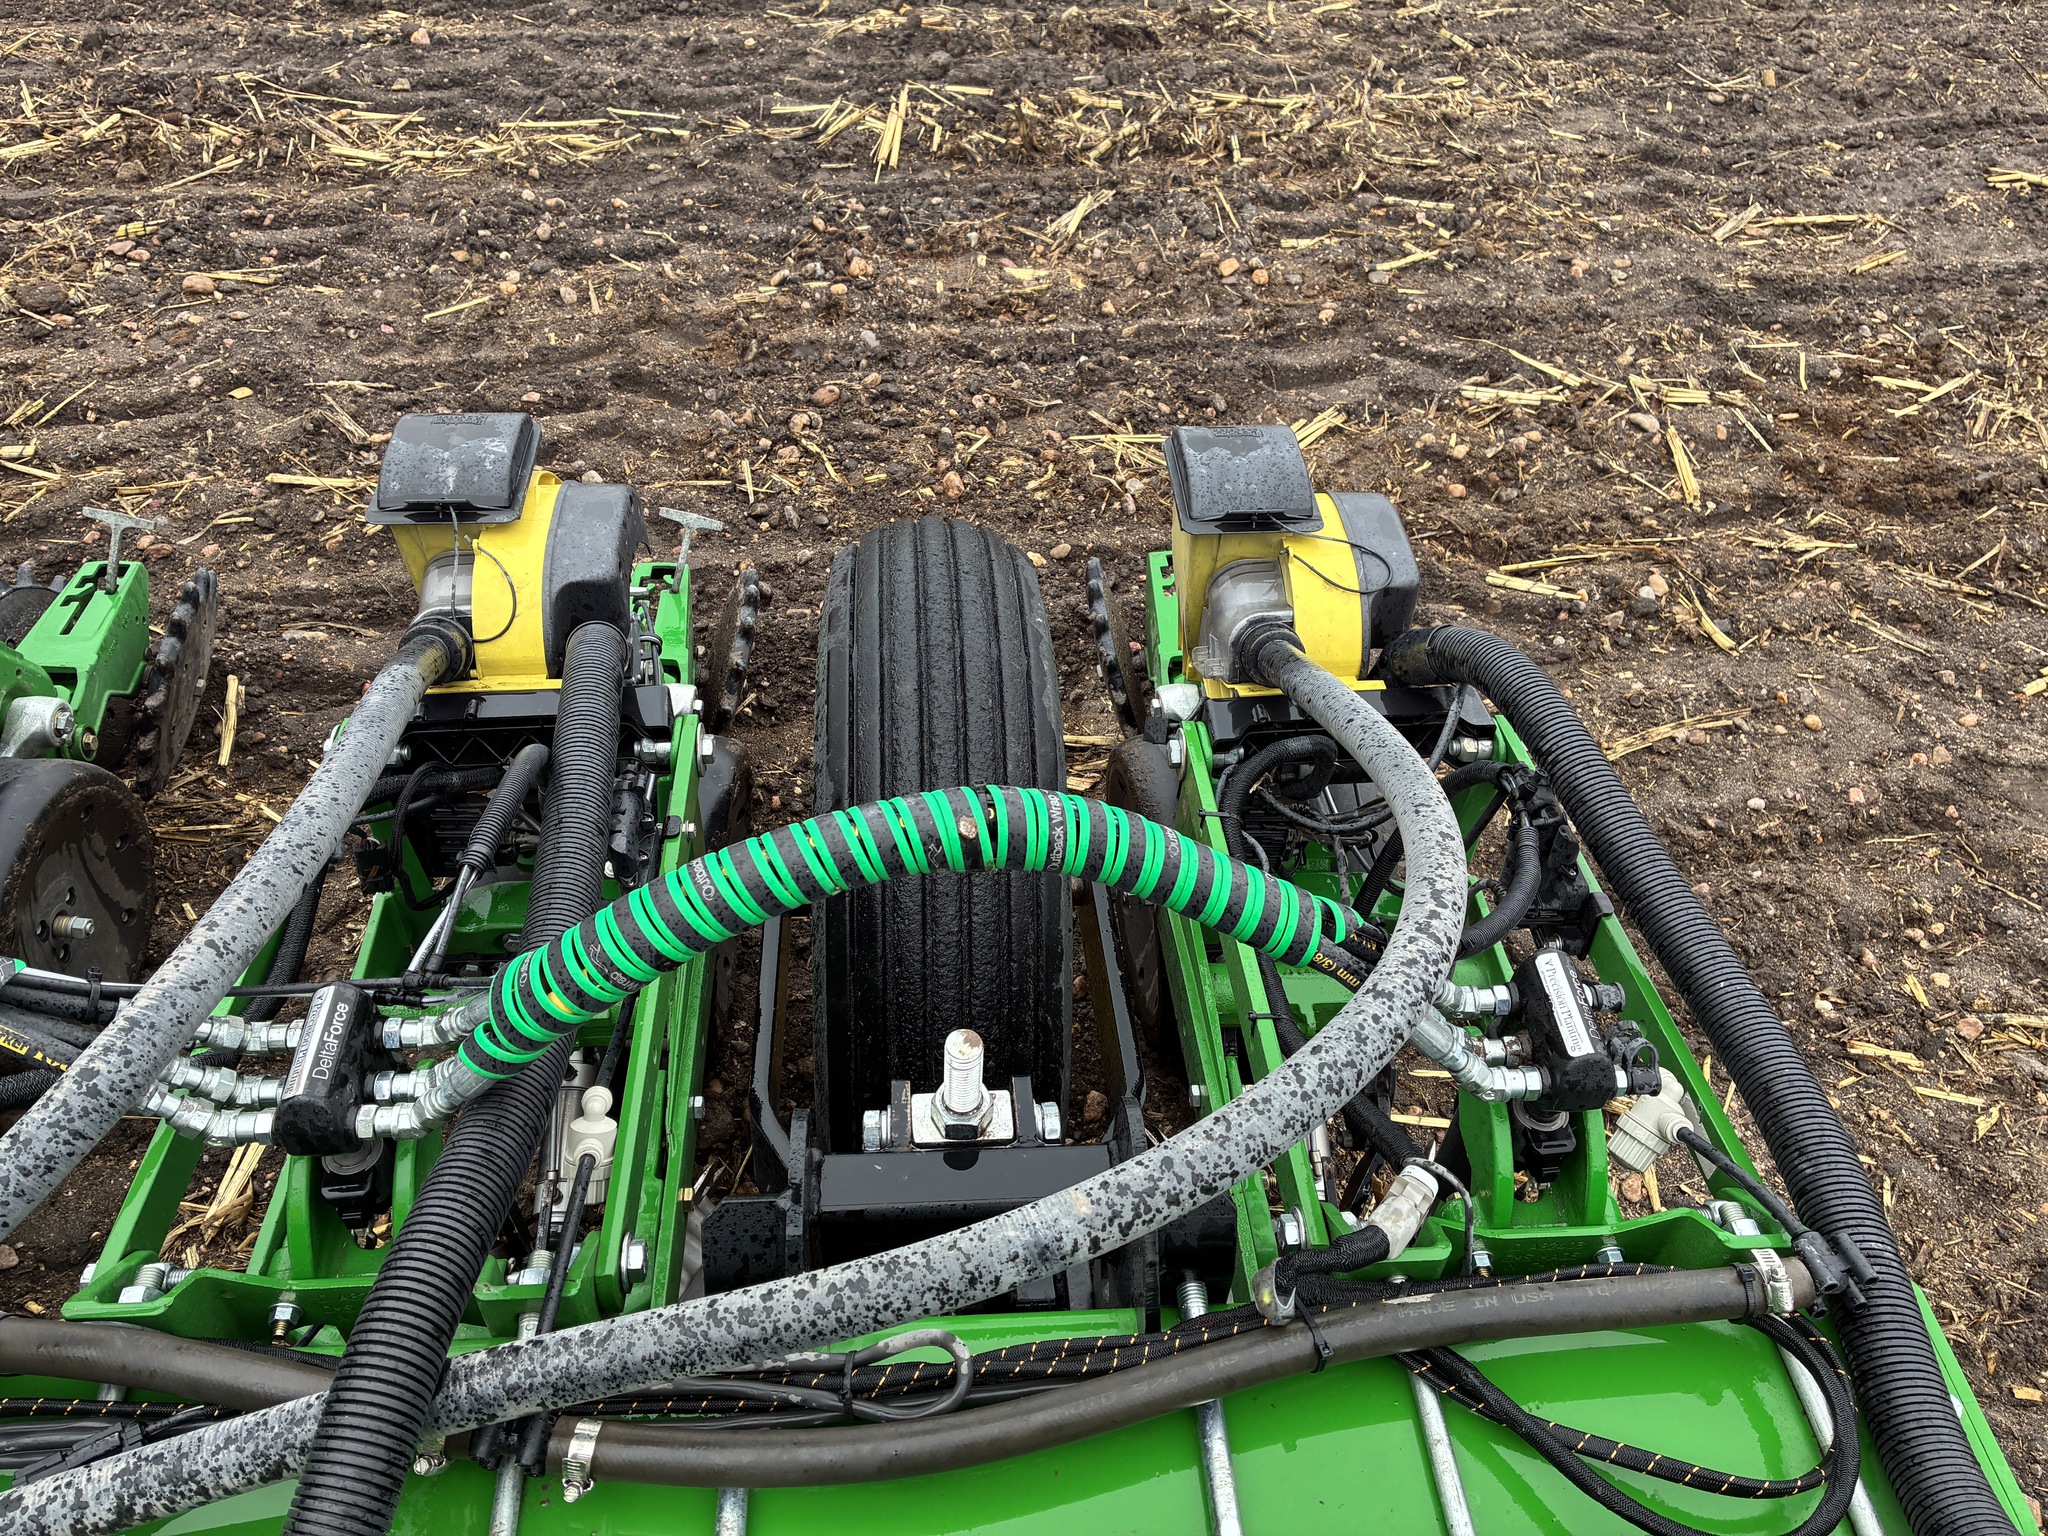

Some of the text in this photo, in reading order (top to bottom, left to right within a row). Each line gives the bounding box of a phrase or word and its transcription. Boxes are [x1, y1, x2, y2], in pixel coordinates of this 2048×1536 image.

[1047, 794, 1064, 872] Outback Wrap
[1336, 968, 1361, 987] mm
[1545, 967, 1569, 1010] Precision
[1561, 1008, 1582, 1052] Planting
[1569, 969, 1601, 1040] DeltaForce
[312, 1002, 349, 1079] DeltaForce
[1398, 1300, 1457, 1318] MADE
[1472, 1298, 1500, 1310] IN
[1511, 1289, 1555, 1305] USA
